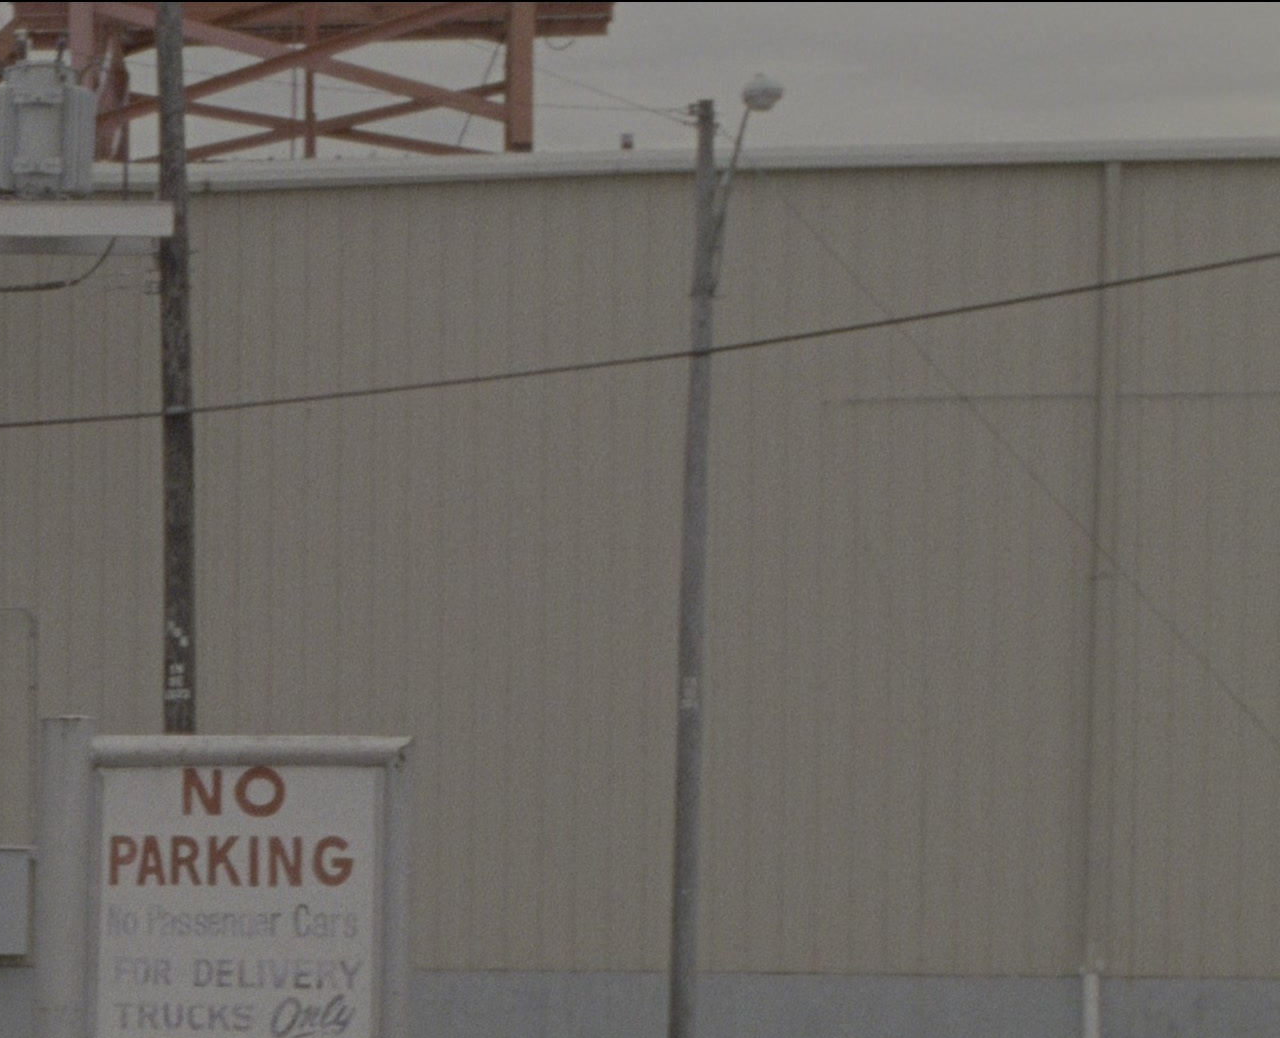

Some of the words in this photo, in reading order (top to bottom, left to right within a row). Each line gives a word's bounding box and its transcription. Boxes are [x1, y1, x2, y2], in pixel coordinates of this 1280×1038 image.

[182, 765, 285, 817] NO
[108, 835, 354, 888] PARKING
[293, 903, 358, 938] Cars
[113, 957, 172, 986] FOR
[192, 958, 362, 990] DELIVERY
[113, 1001, 254, 1032] TRUCKS
